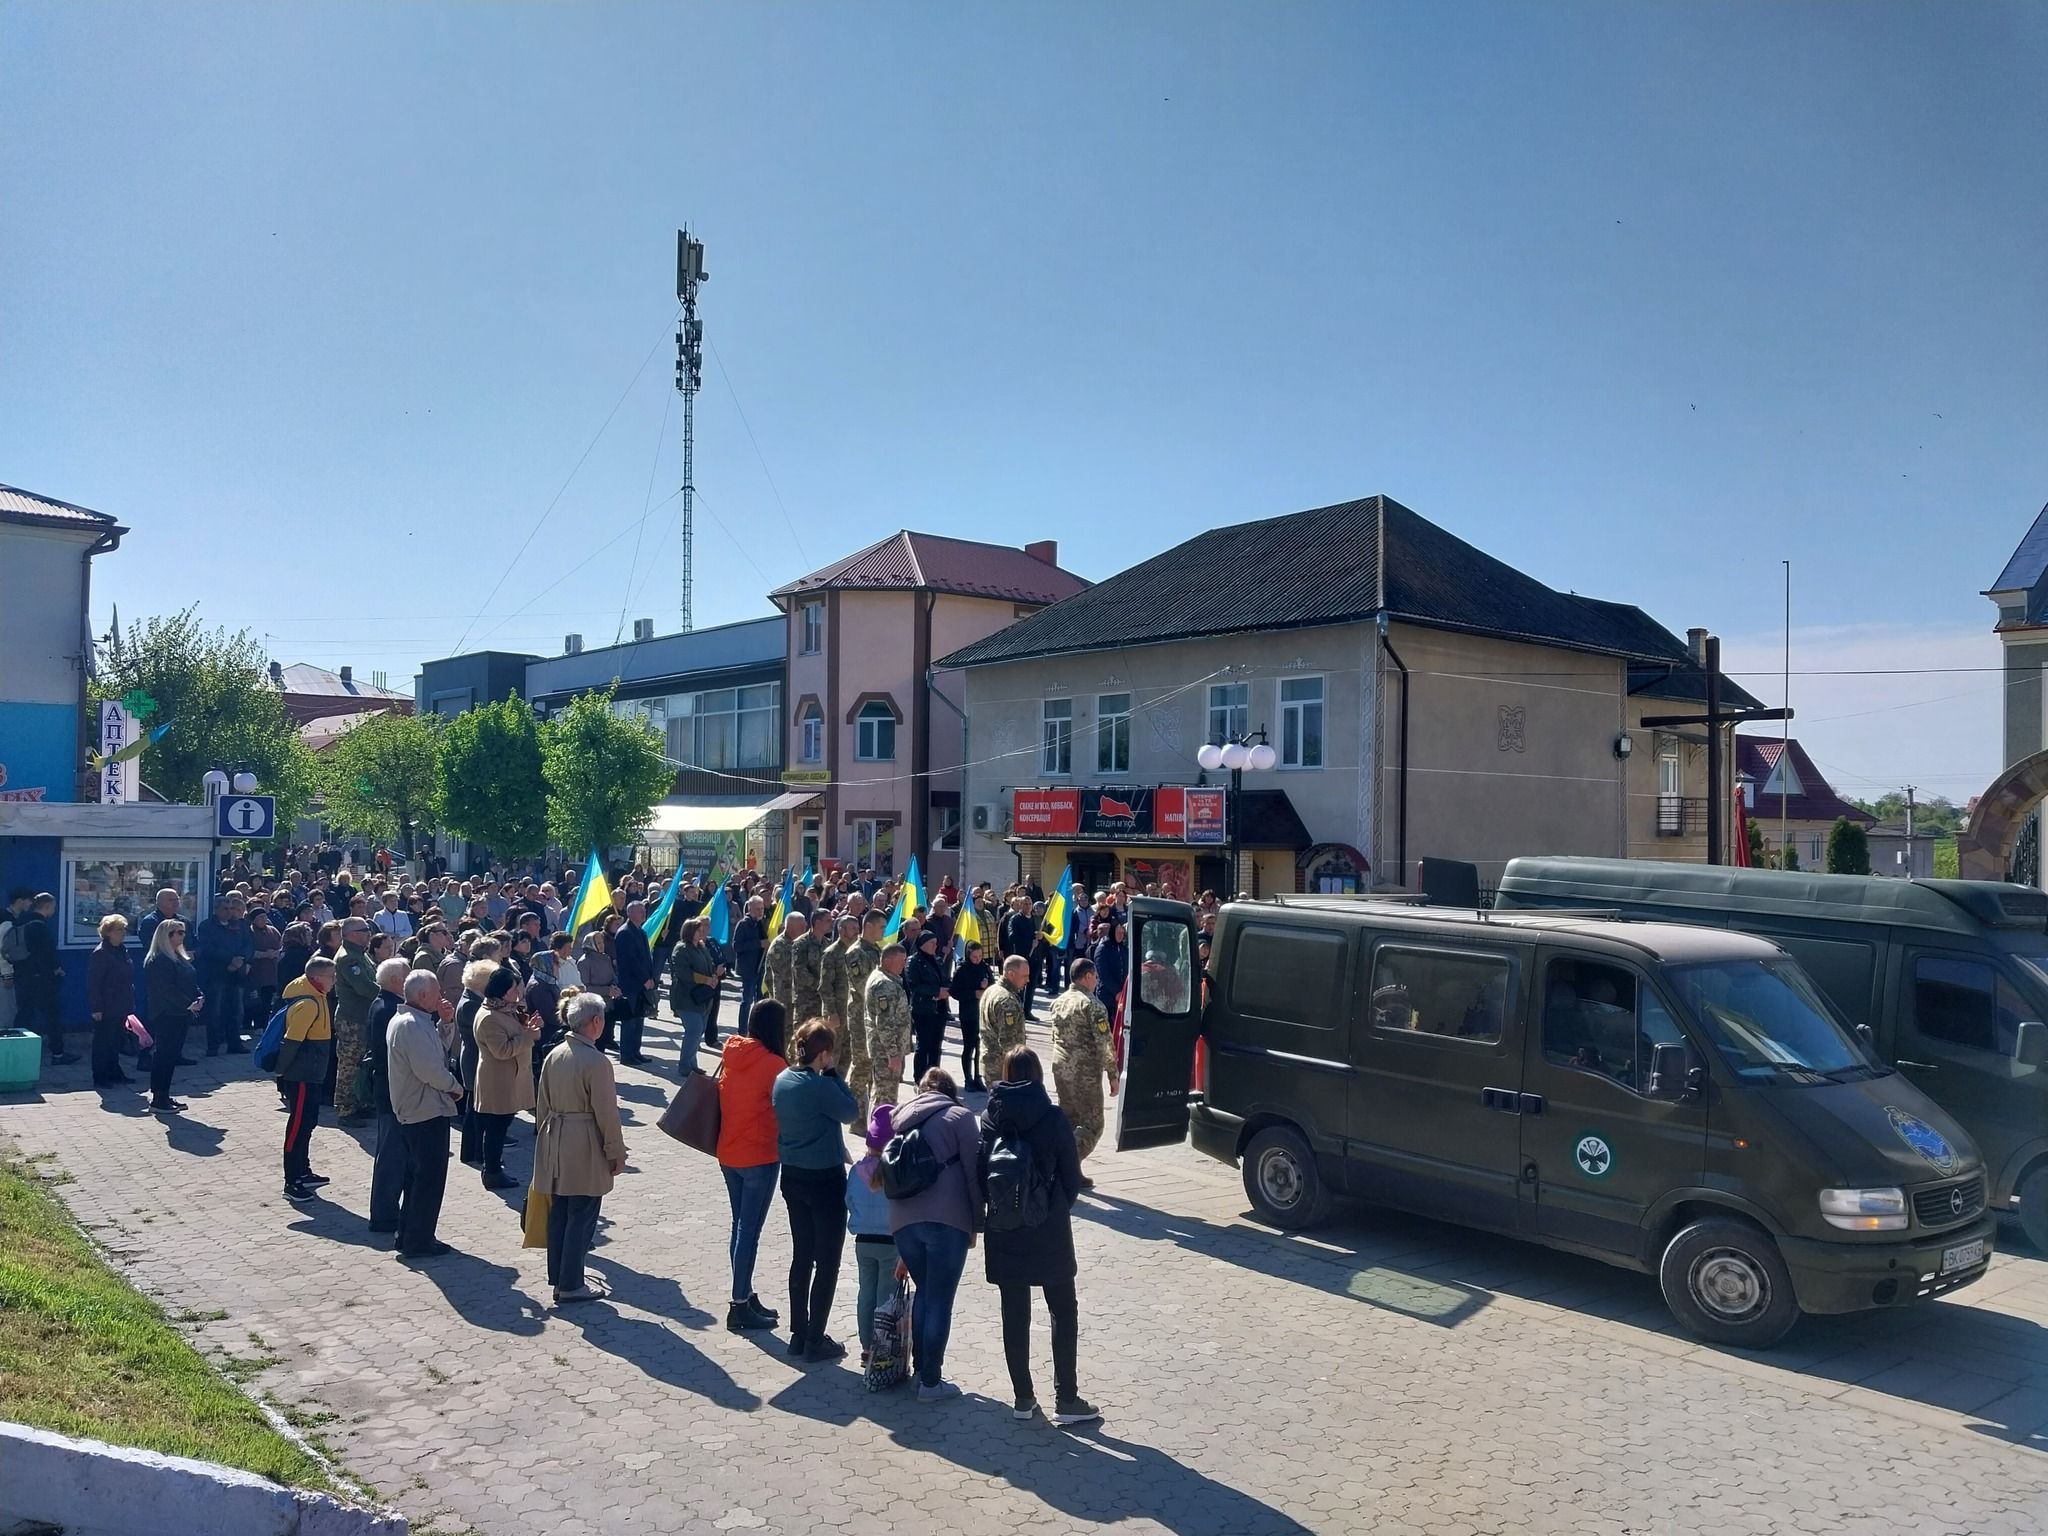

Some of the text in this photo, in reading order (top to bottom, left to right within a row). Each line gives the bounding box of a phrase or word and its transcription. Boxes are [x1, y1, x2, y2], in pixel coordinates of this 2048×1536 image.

[1095, 820, 1136, 828] СТУДІЯ М'ЯСА
[685, 832, 721, 844] ЧАРІВНИЦЯ
